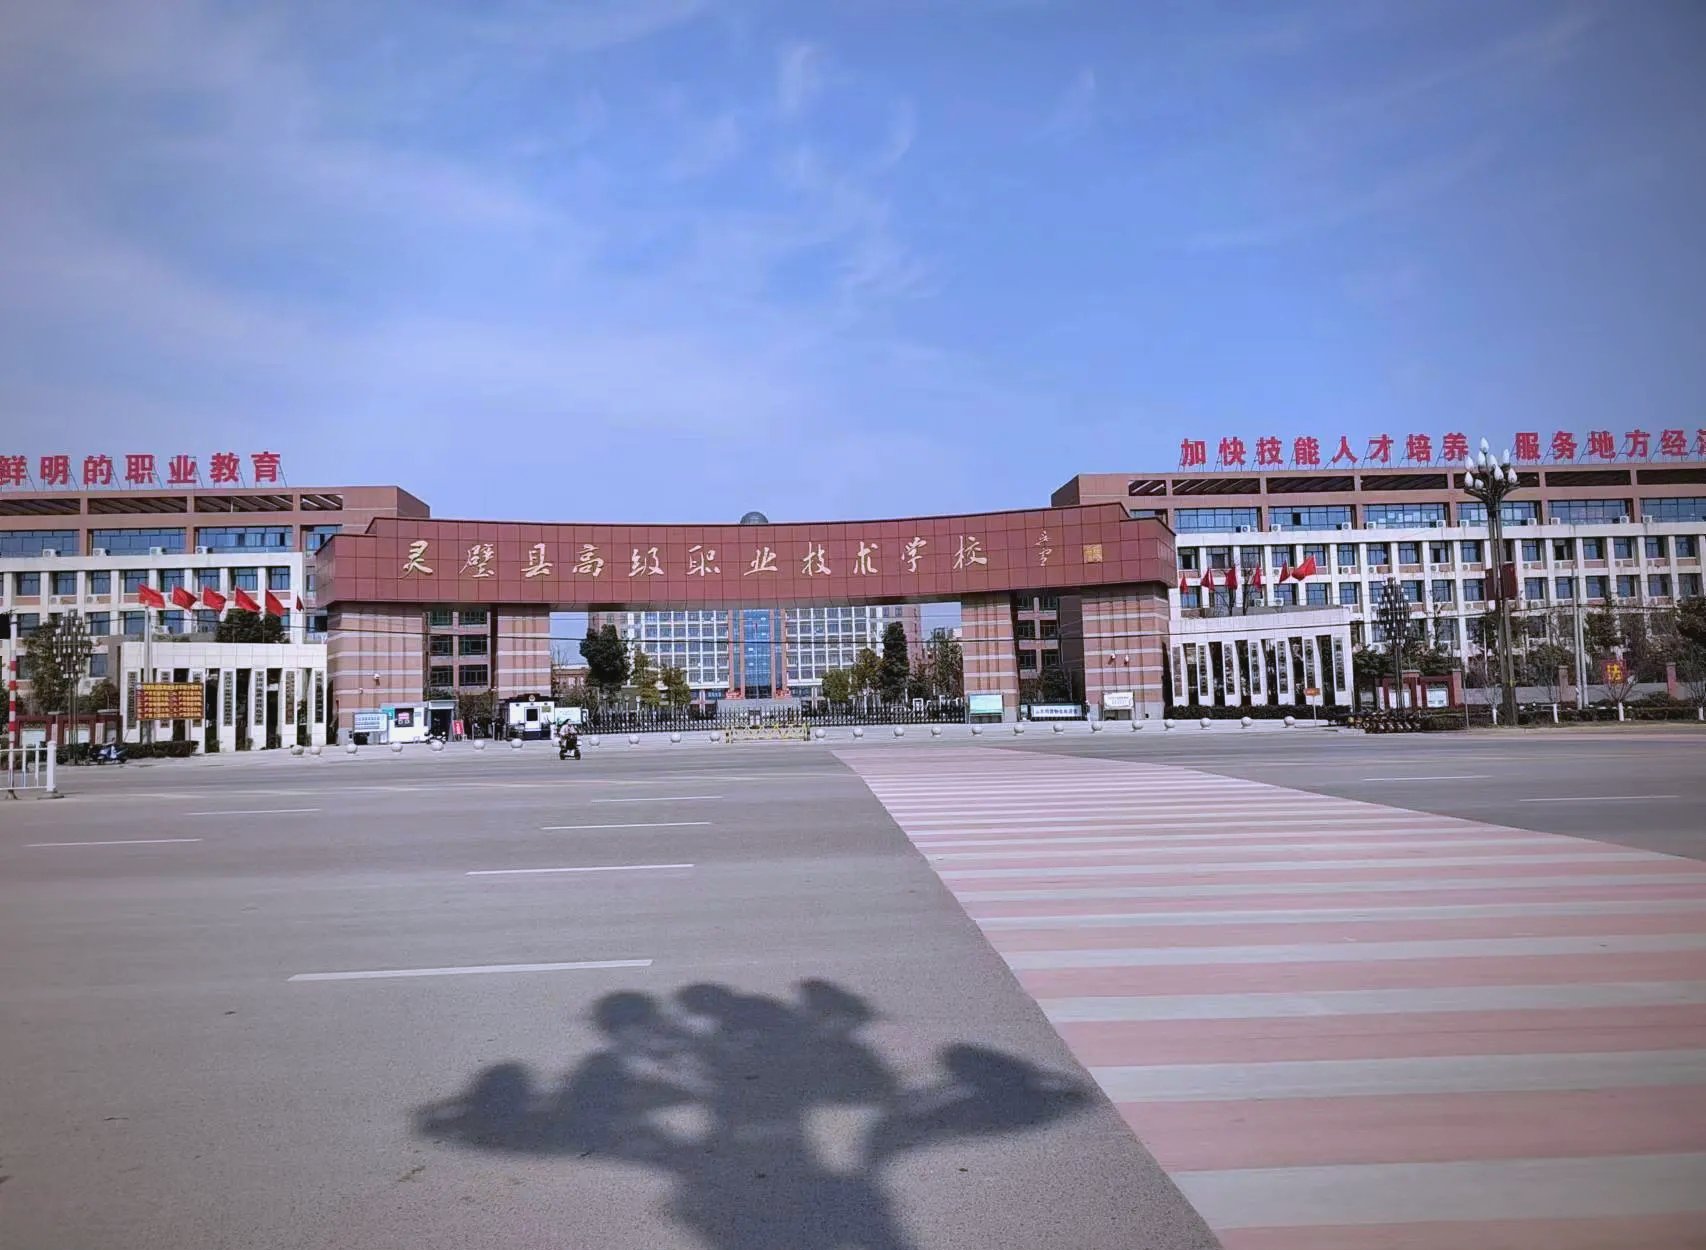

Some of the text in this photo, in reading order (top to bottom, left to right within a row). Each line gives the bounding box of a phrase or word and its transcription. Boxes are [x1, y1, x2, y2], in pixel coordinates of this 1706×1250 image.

[1180, 432, 1469, 467] 加快技能人才培养
[0, 451, 281, 486] 鲜明的职业教育
[399, 535, 988, 580] 灵璧县高级职业技术学校
